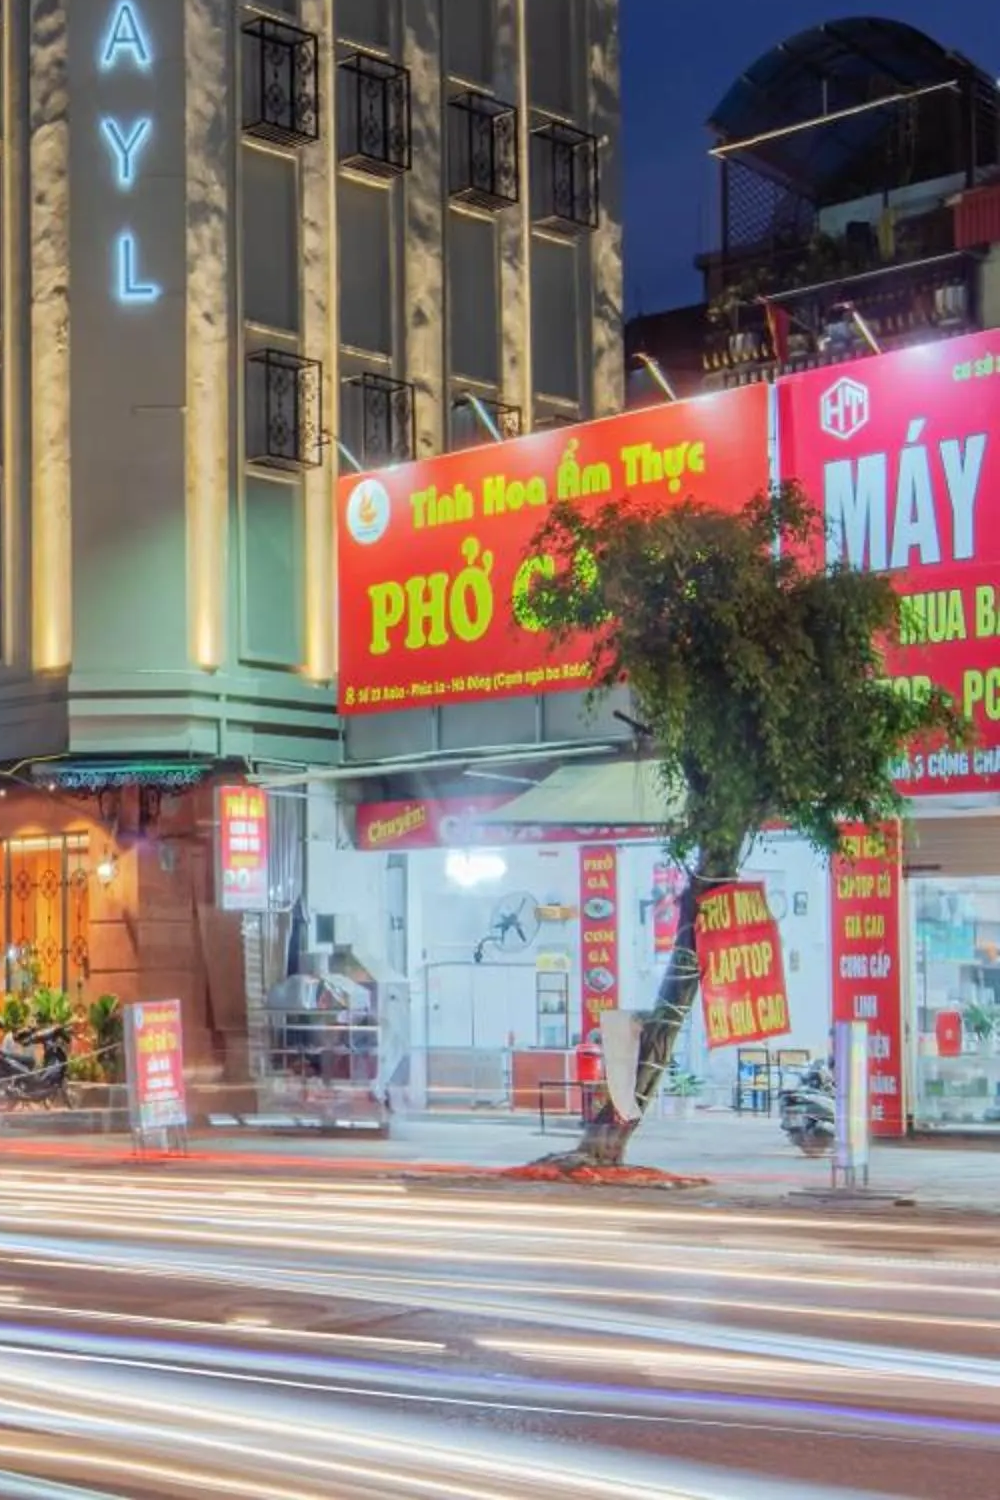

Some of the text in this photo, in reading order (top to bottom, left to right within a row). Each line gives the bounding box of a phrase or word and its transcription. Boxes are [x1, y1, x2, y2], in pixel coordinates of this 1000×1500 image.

[483, 476, 547, 515] Hoa
[621, 440, 705, 493] Thực
[823, 417, 987, 575] MÁY
[369, 536, 494, 655] PHỞ
[900, 585, 1000, 645] MUA B
[709, 940, 773, 986] LAPTOP
[758, 993, 786, 1033] CAO
